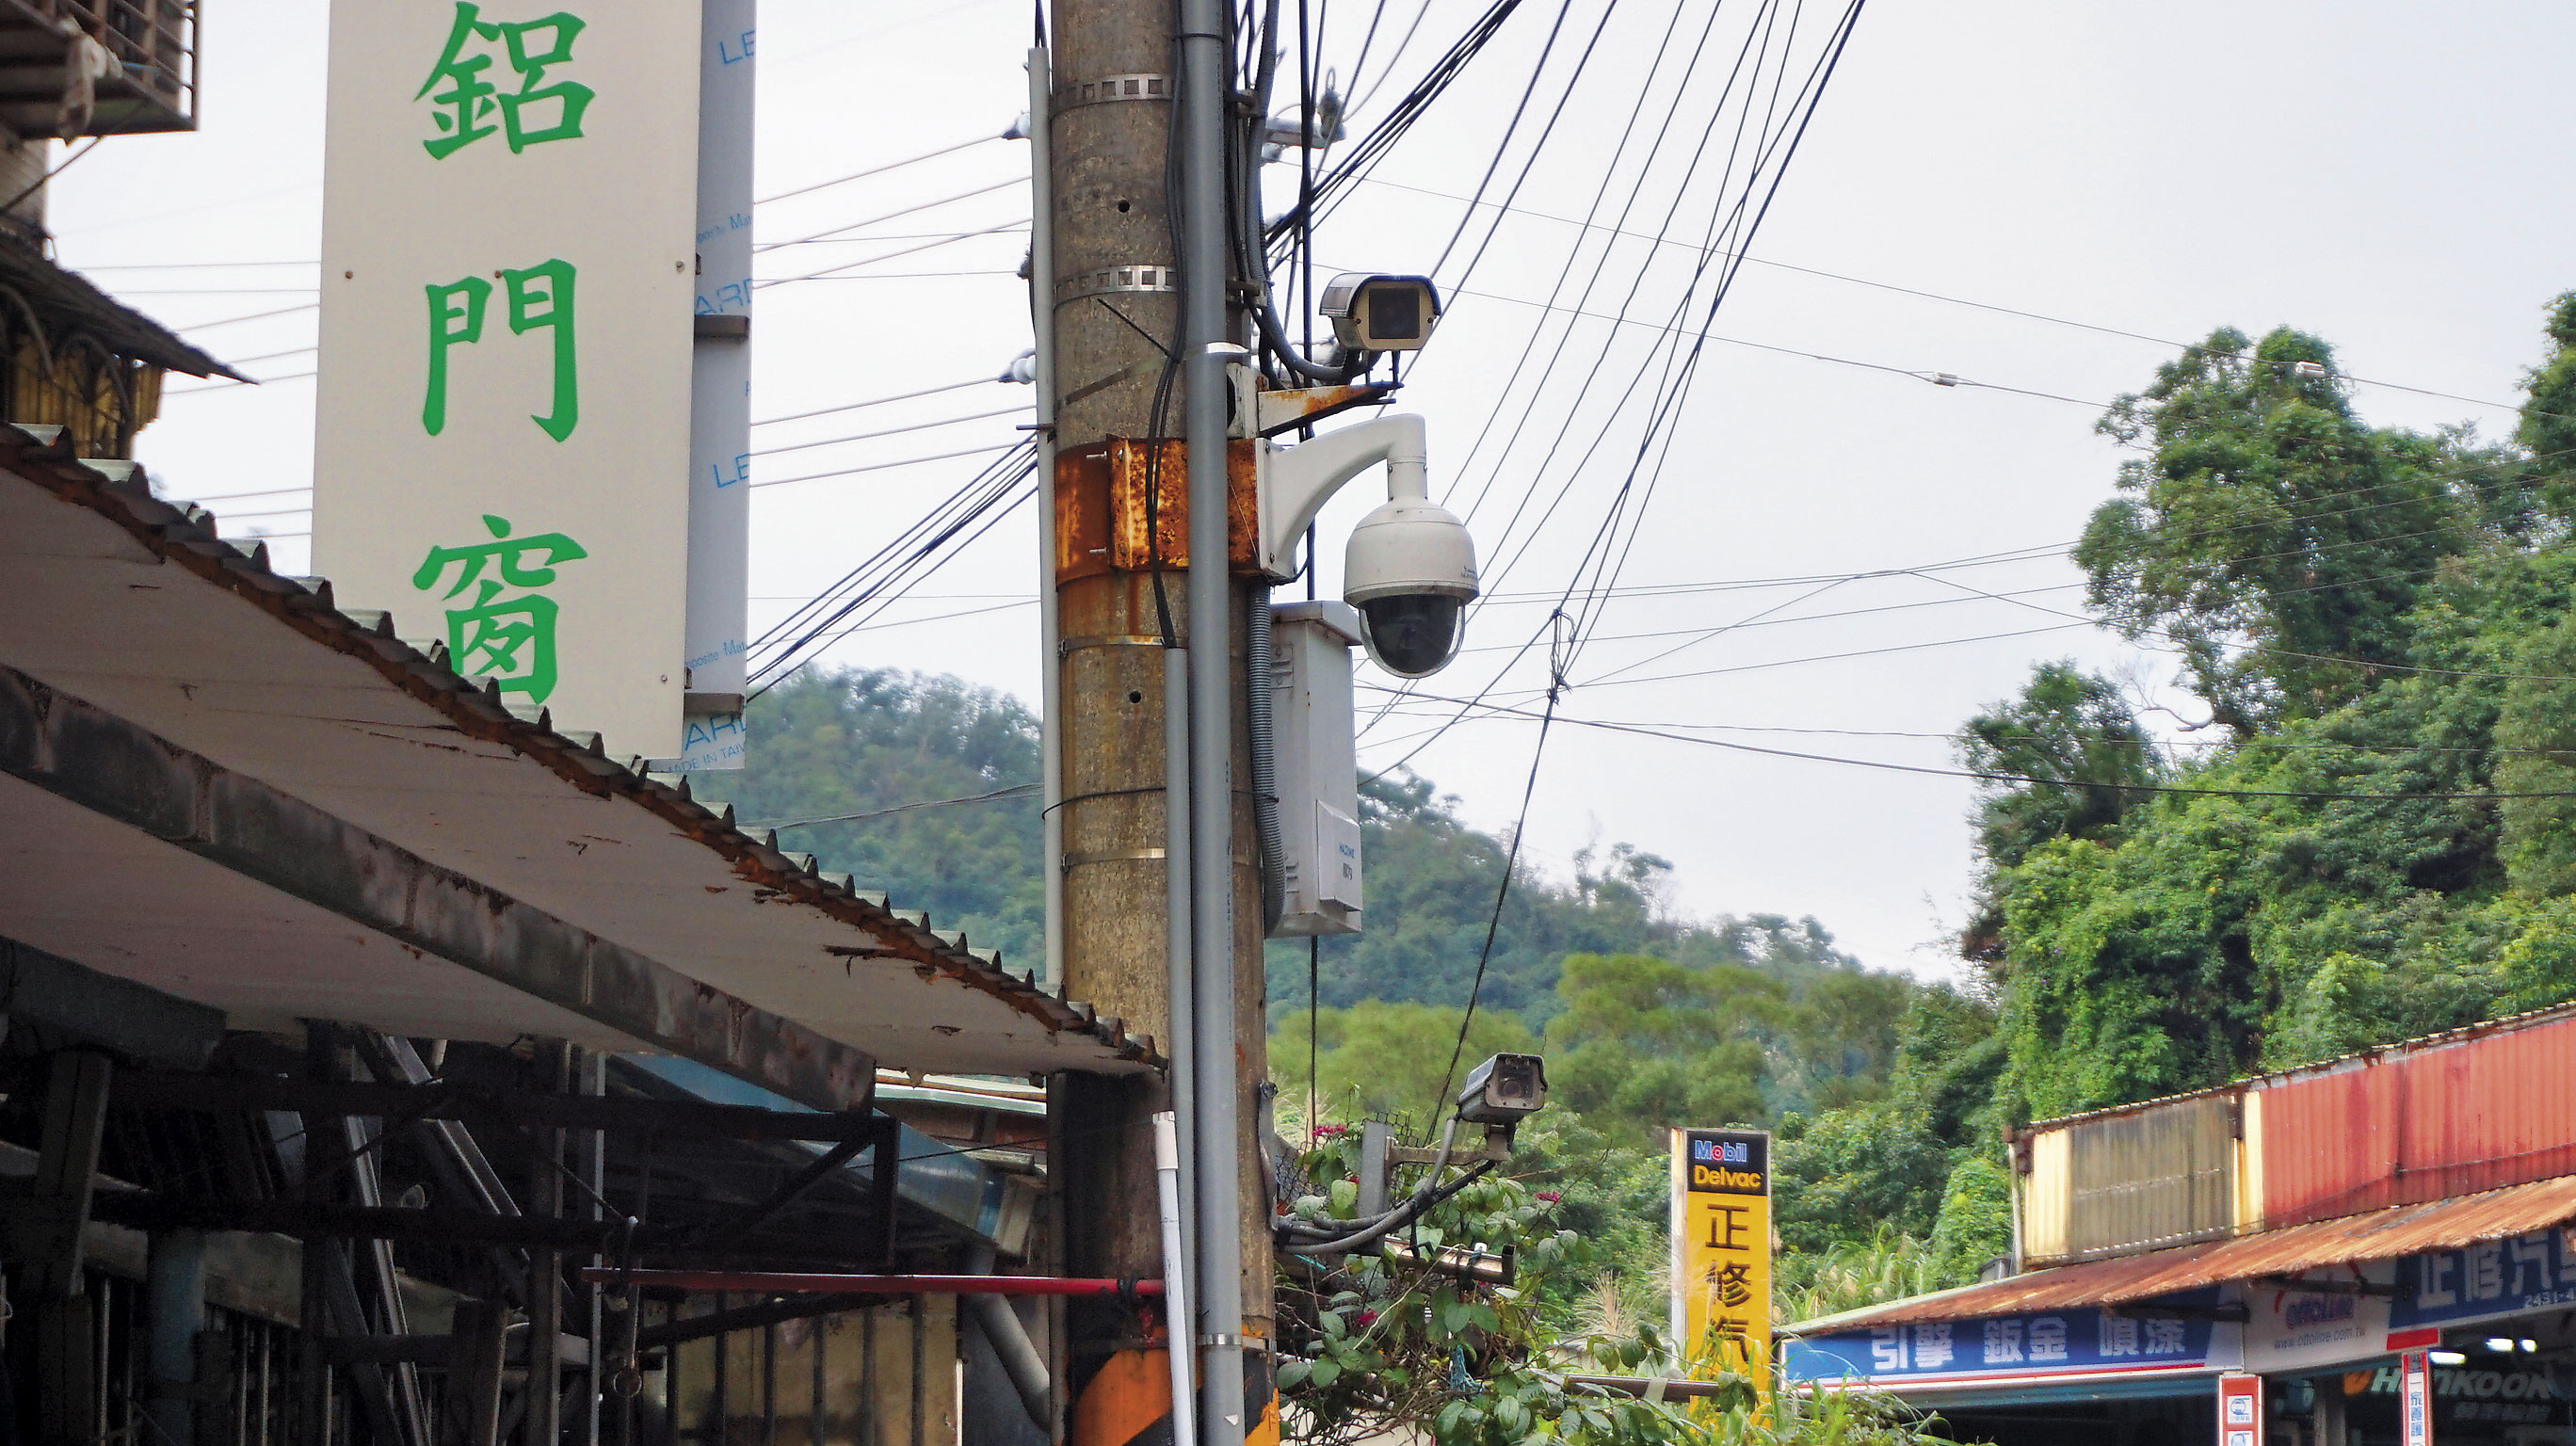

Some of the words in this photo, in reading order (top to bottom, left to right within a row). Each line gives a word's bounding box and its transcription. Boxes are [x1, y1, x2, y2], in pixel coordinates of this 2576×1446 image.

[413, 0, 596, 704] 鋁門窗
[1695, 1139, 1748, 1163] Mobil
[1694, 1164, 1762, 1188] Delvac
[1870, 1323, 1955, 1371] 引擎
[1983, 1316, 2069, 1364] 鈑金
